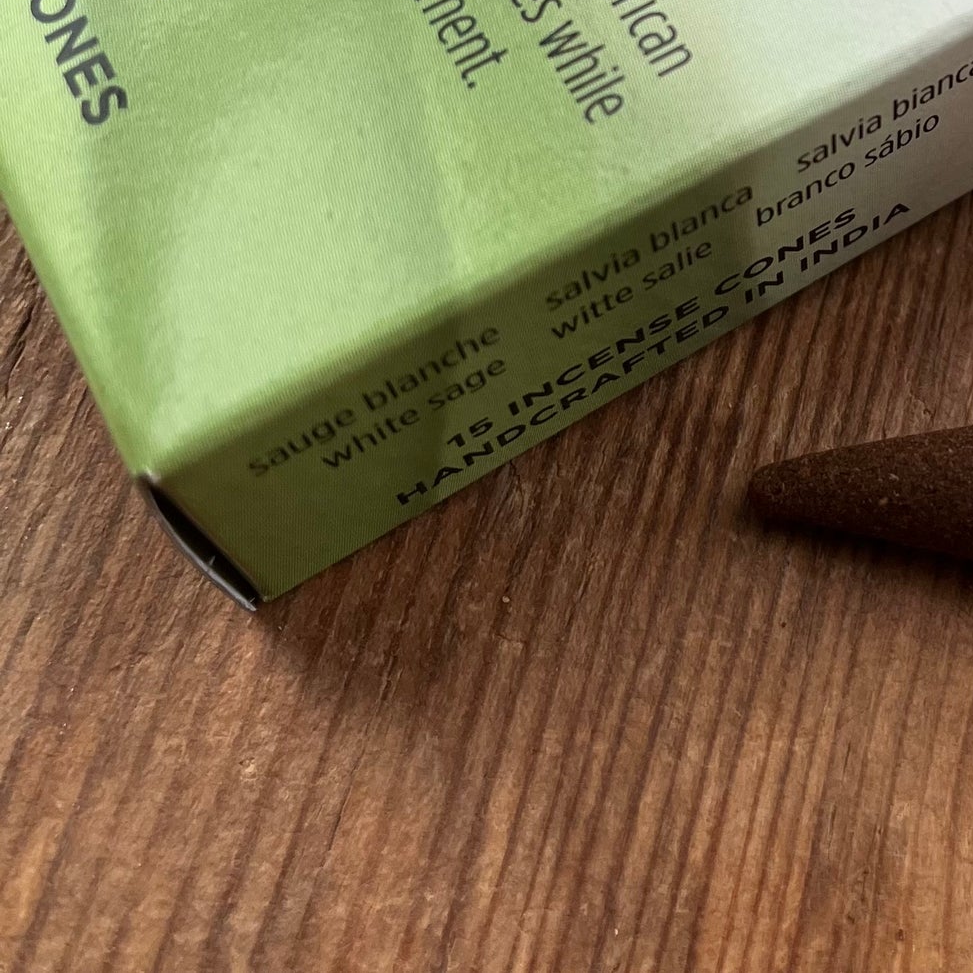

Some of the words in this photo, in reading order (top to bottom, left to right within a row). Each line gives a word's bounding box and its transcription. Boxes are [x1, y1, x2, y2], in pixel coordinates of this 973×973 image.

[539, 20, 625, 124] while
[757, 162, 855, 226] branco
[864, 114, 940, 167] sábio
[797, 114, 882, 173] salvia
[546, 248, 641, 311] salvia
[650, 186, 753, 252] blanca
[551, 286, 633, 339] witte
[642, 241, 712, 290] salie
[396, 306, 730, 505] HANDCRAFTED
[745, 271, 784, 303] IN
[801, 203, 911, 272] INDIA
[447, 417, 493, 448] 15
[508, 296, 700, 415] INCENSE
[714, 208, 856, 296] CONES
[248, 406, 355, 476] sauge
[362, 326, 499, 411] blanche
[322, 407, 420, 468] white
[427, 358, 506, 411] sage
